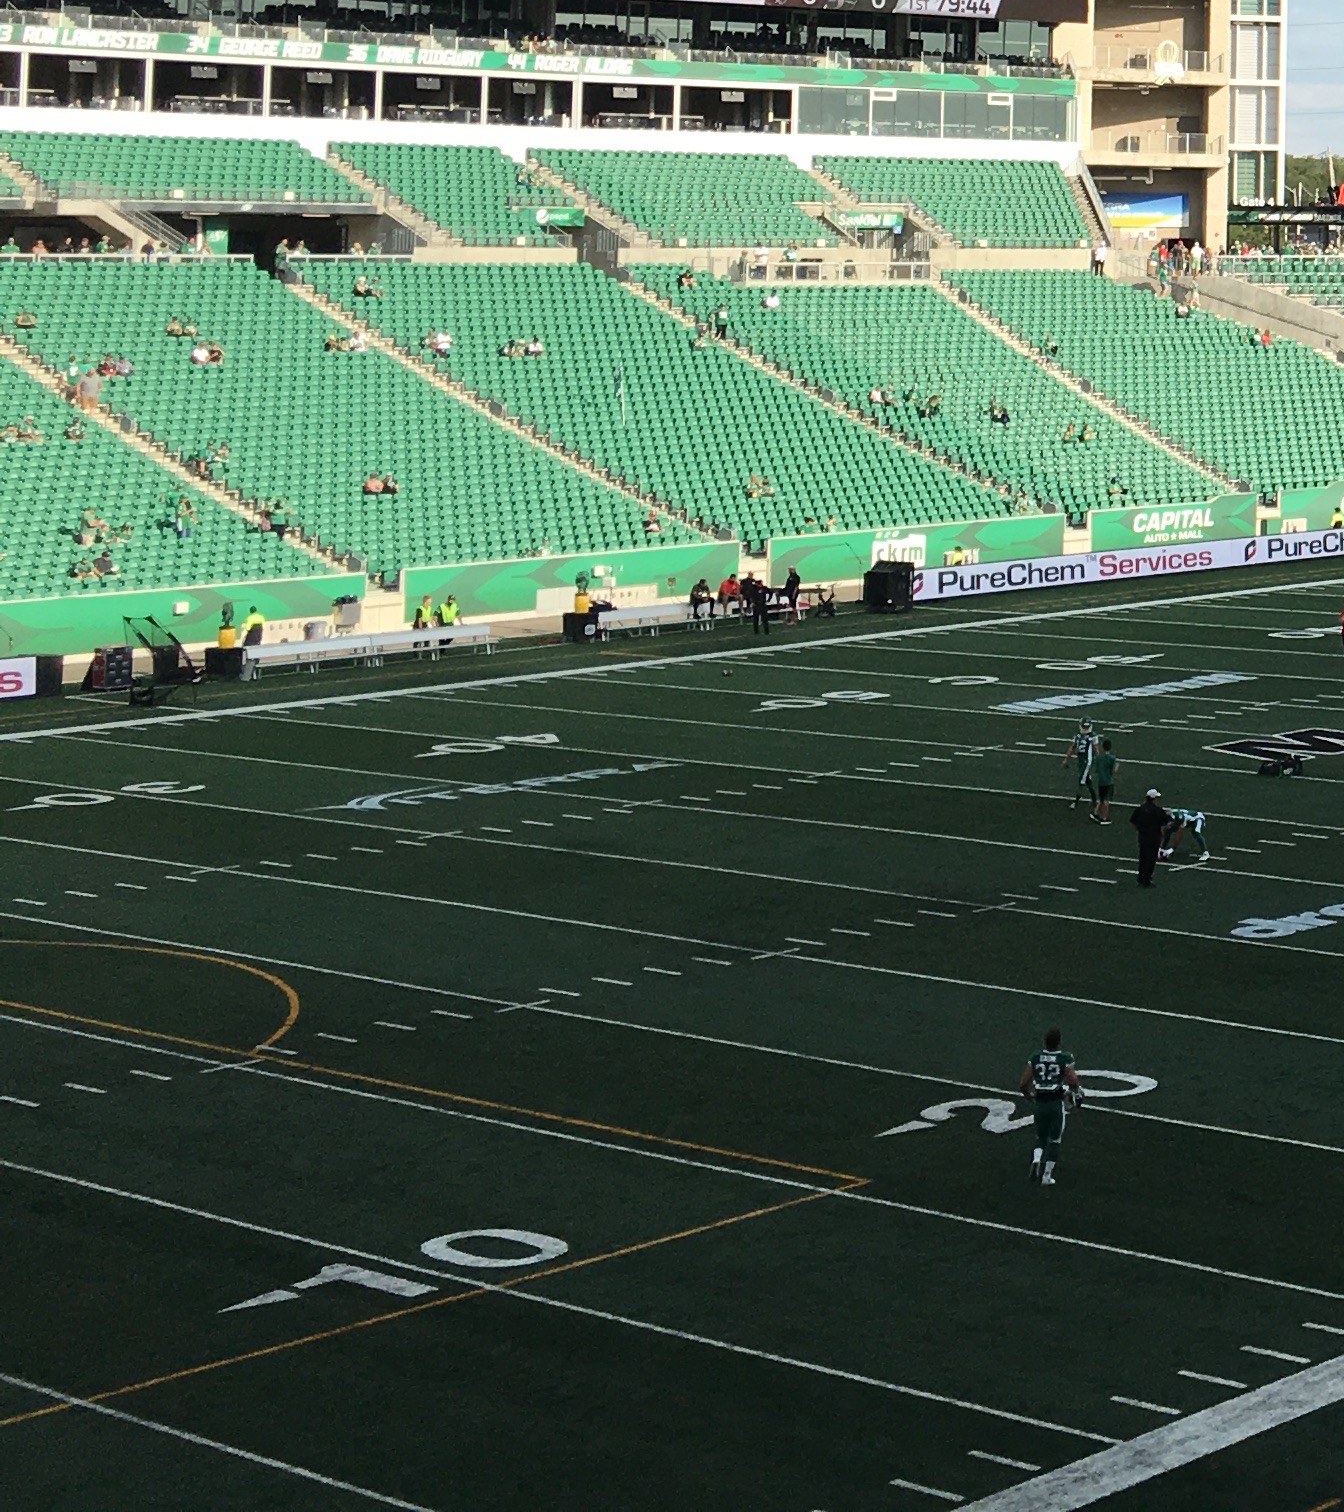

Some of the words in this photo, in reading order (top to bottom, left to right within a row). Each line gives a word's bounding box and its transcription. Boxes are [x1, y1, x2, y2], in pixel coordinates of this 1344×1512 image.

[22, 25, 57, 45] RON
[61, 28, 159, 51] LANCASTER
[186, 36, 208, 53] 34
[218, 38, 281, 57] GEORGE
[282, 42, 322, 59] REED
[417, 49, 484, 68] RIDGWAY
[534, 54, 579, 73] ROGER
[1240, 197, 1265, 208] Gate
[1267, 197, 1275, 207] 4
[838, 212, 883, 228] SaskTel
[1133, 508, 1216, 533] CAPITAL
[1144, 533, 1168, 544] AUTO
[1178, 529, 1204, 541] MALL
[876, 541, 924, 561] ckrm
[1099, 548, 1213, 577] Services
[920, 1069, 1159, 1134] 20
[290, 1228, 569, 1297] 10
